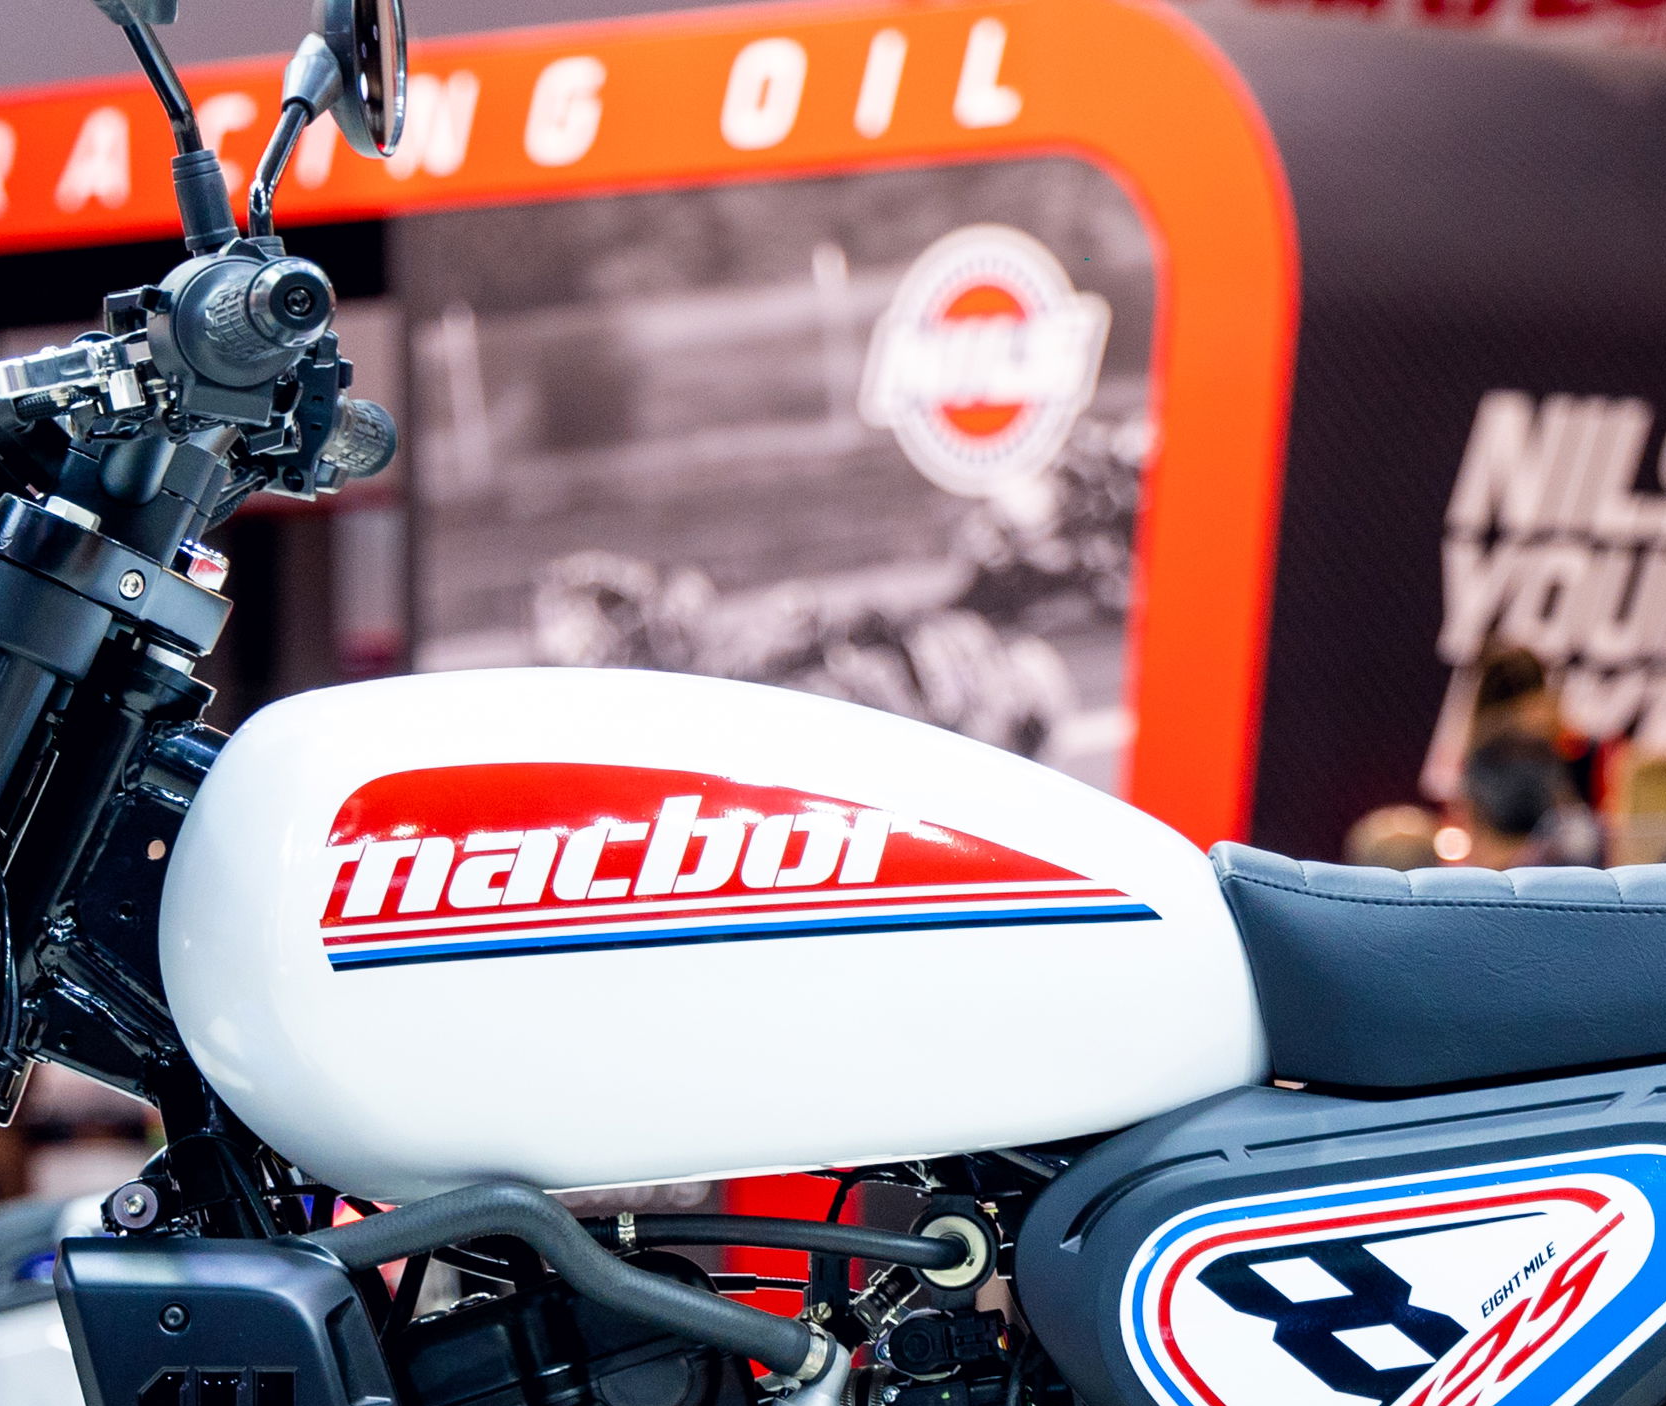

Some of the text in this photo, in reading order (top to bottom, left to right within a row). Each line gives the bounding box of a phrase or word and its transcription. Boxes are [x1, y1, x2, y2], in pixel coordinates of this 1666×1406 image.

[720, 17, 1024, 151] OIL
[322, 794, 921, 920] macbor
[1480, 1241, 1557, 1319] EIGHT MILE
